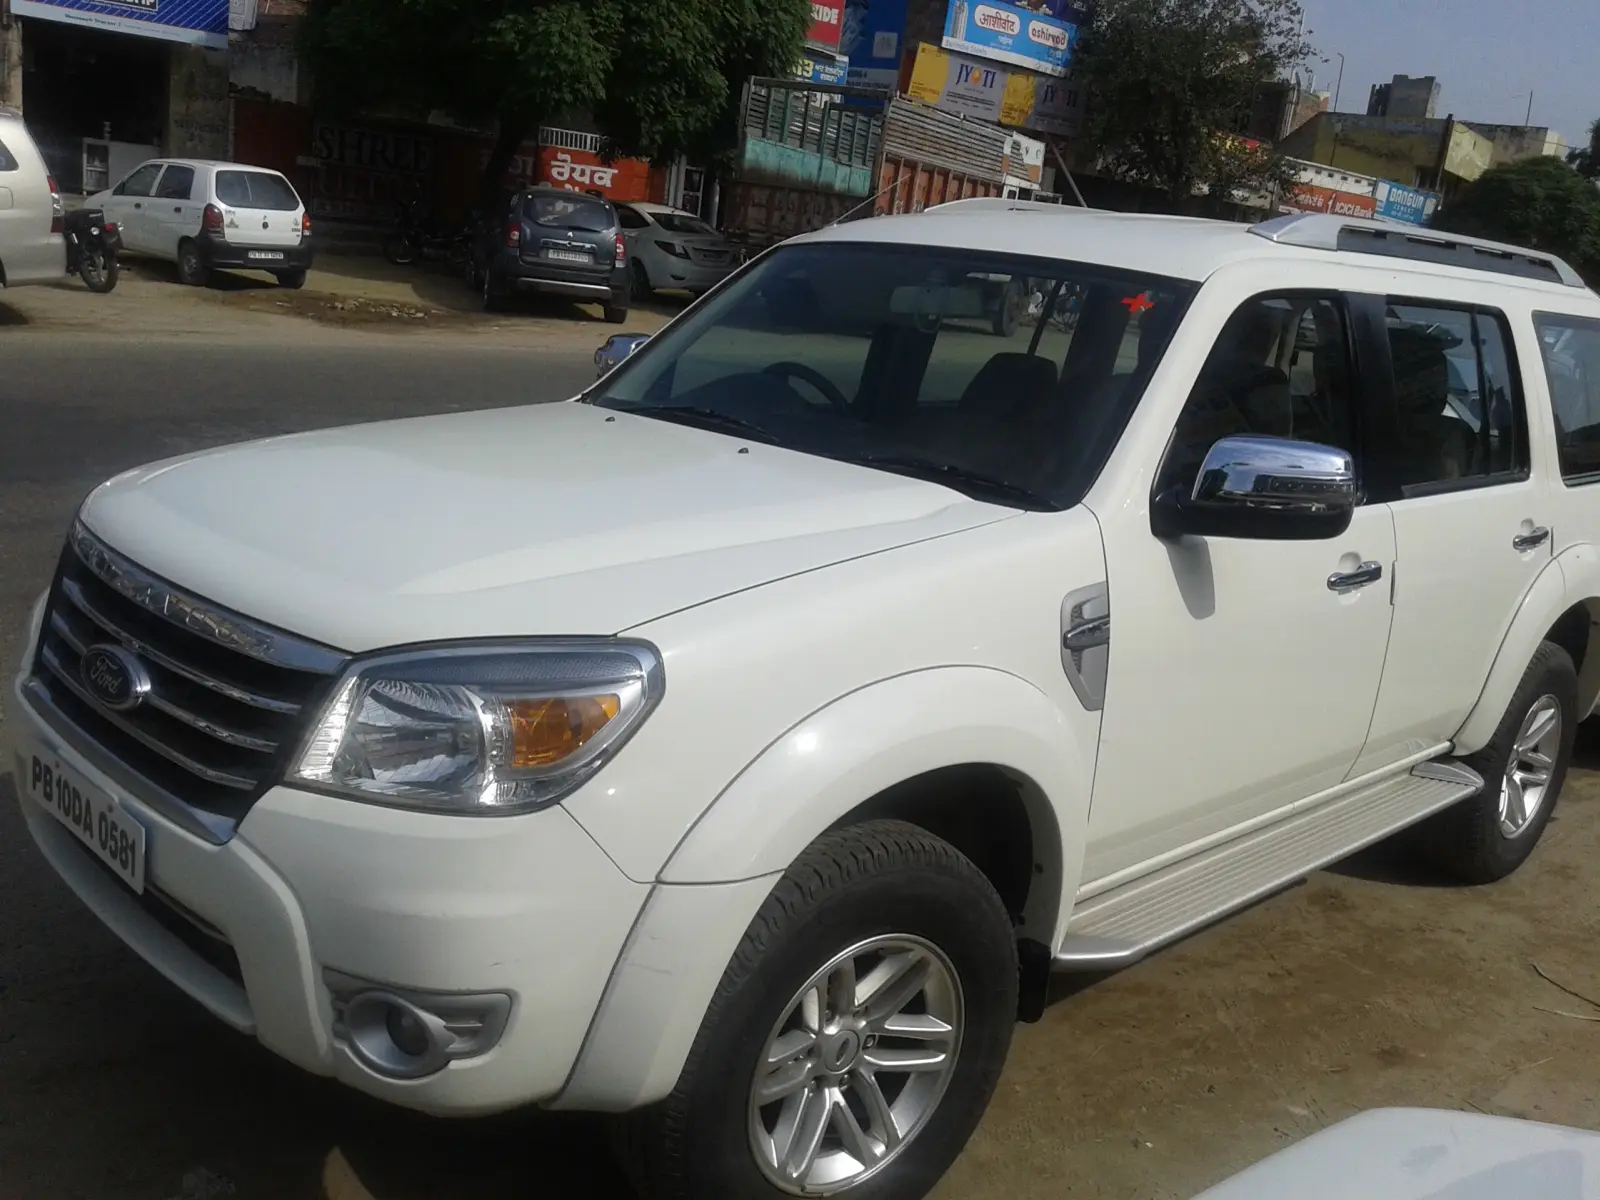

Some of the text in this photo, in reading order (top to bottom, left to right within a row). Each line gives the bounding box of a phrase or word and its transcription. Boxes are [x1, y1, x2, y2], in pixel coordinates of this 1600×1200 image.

[1031, 27, 1067, 46] ashirvad
[955, 63, 997, 89] JYOTI
[1334, 201, 1354, 216] ICICI
[1354, 205, 1374, 219] Bank
[1389, 187, 1424, 210] BANGUR
[89, 655, 121, 695] Ford
[98, 811, 136, 878] 0581
